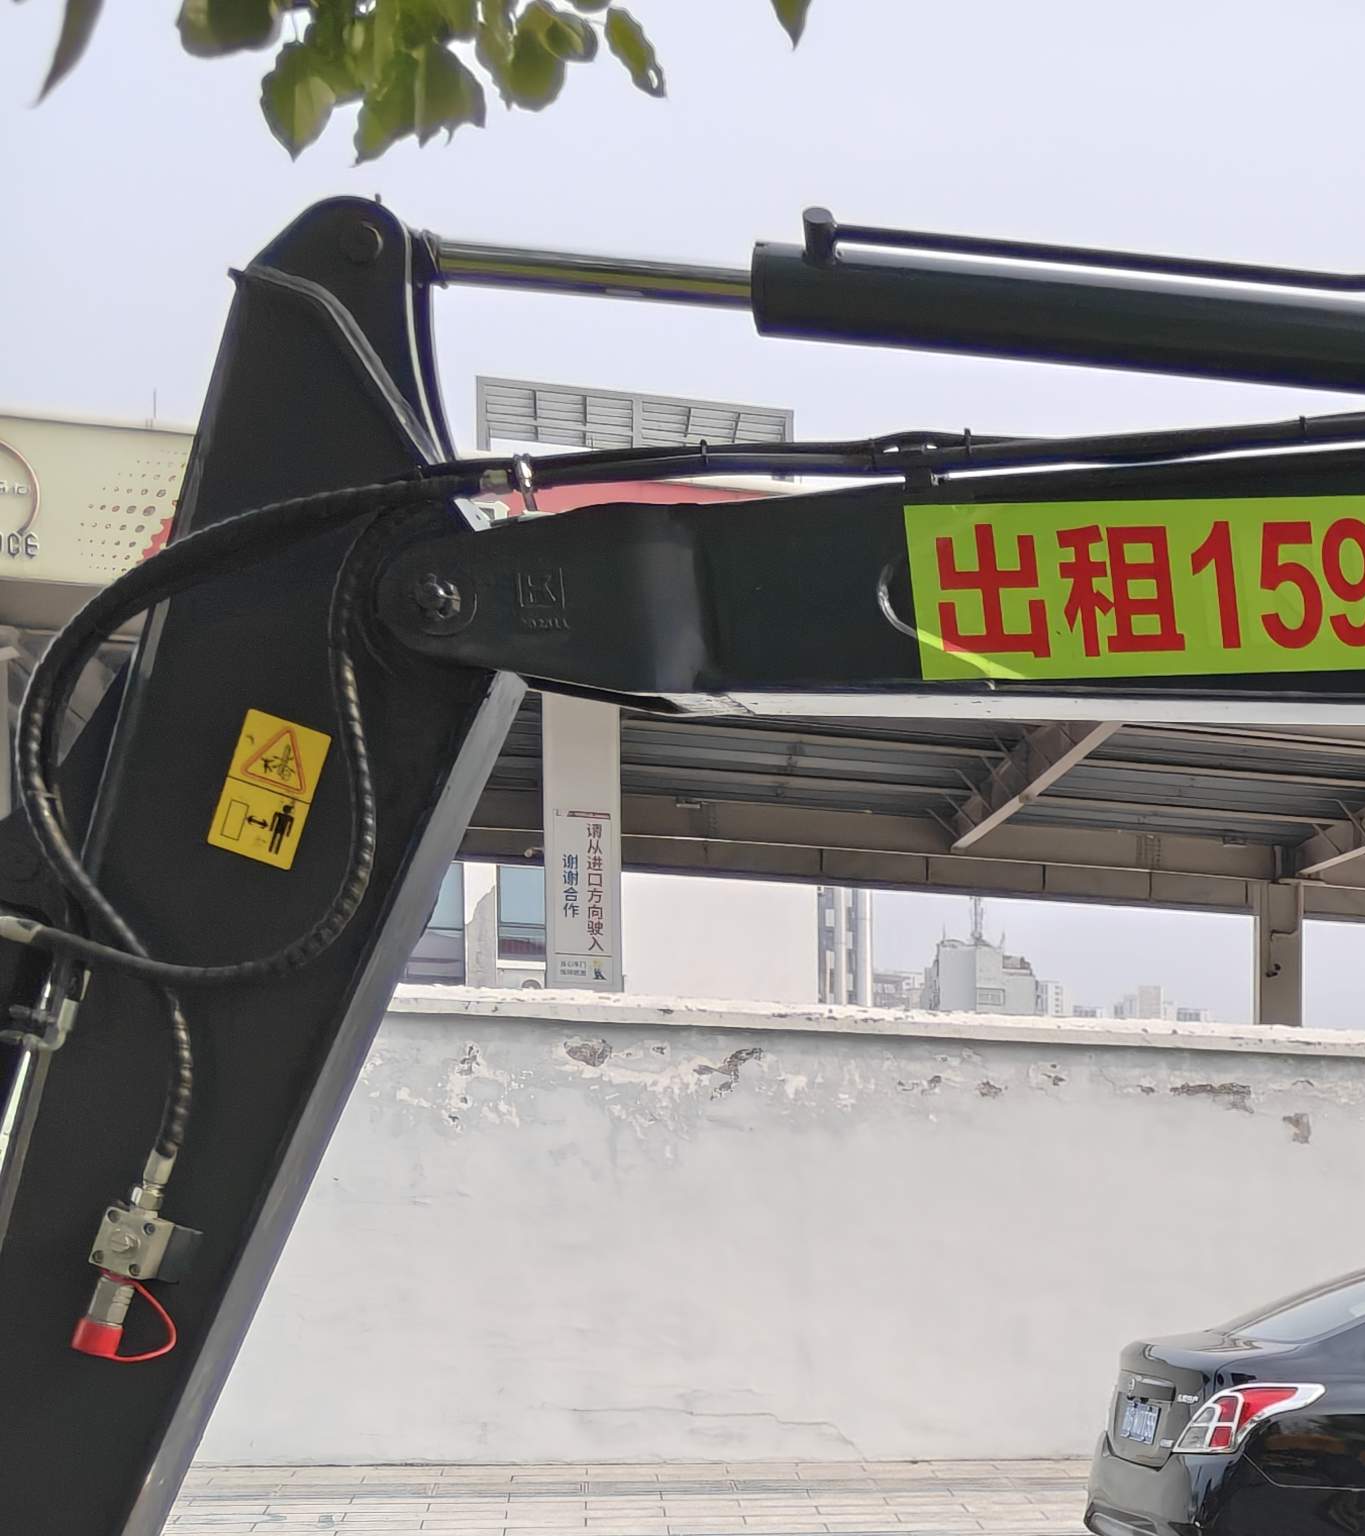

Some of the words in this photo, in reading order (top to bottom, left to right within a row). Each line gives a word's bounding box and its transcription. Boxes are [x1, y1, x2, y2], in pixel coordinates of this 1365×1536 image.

[562, 853, 580, 918] 谢谢合作
[586, 823, 604, 952] 请从进口方向驶入
